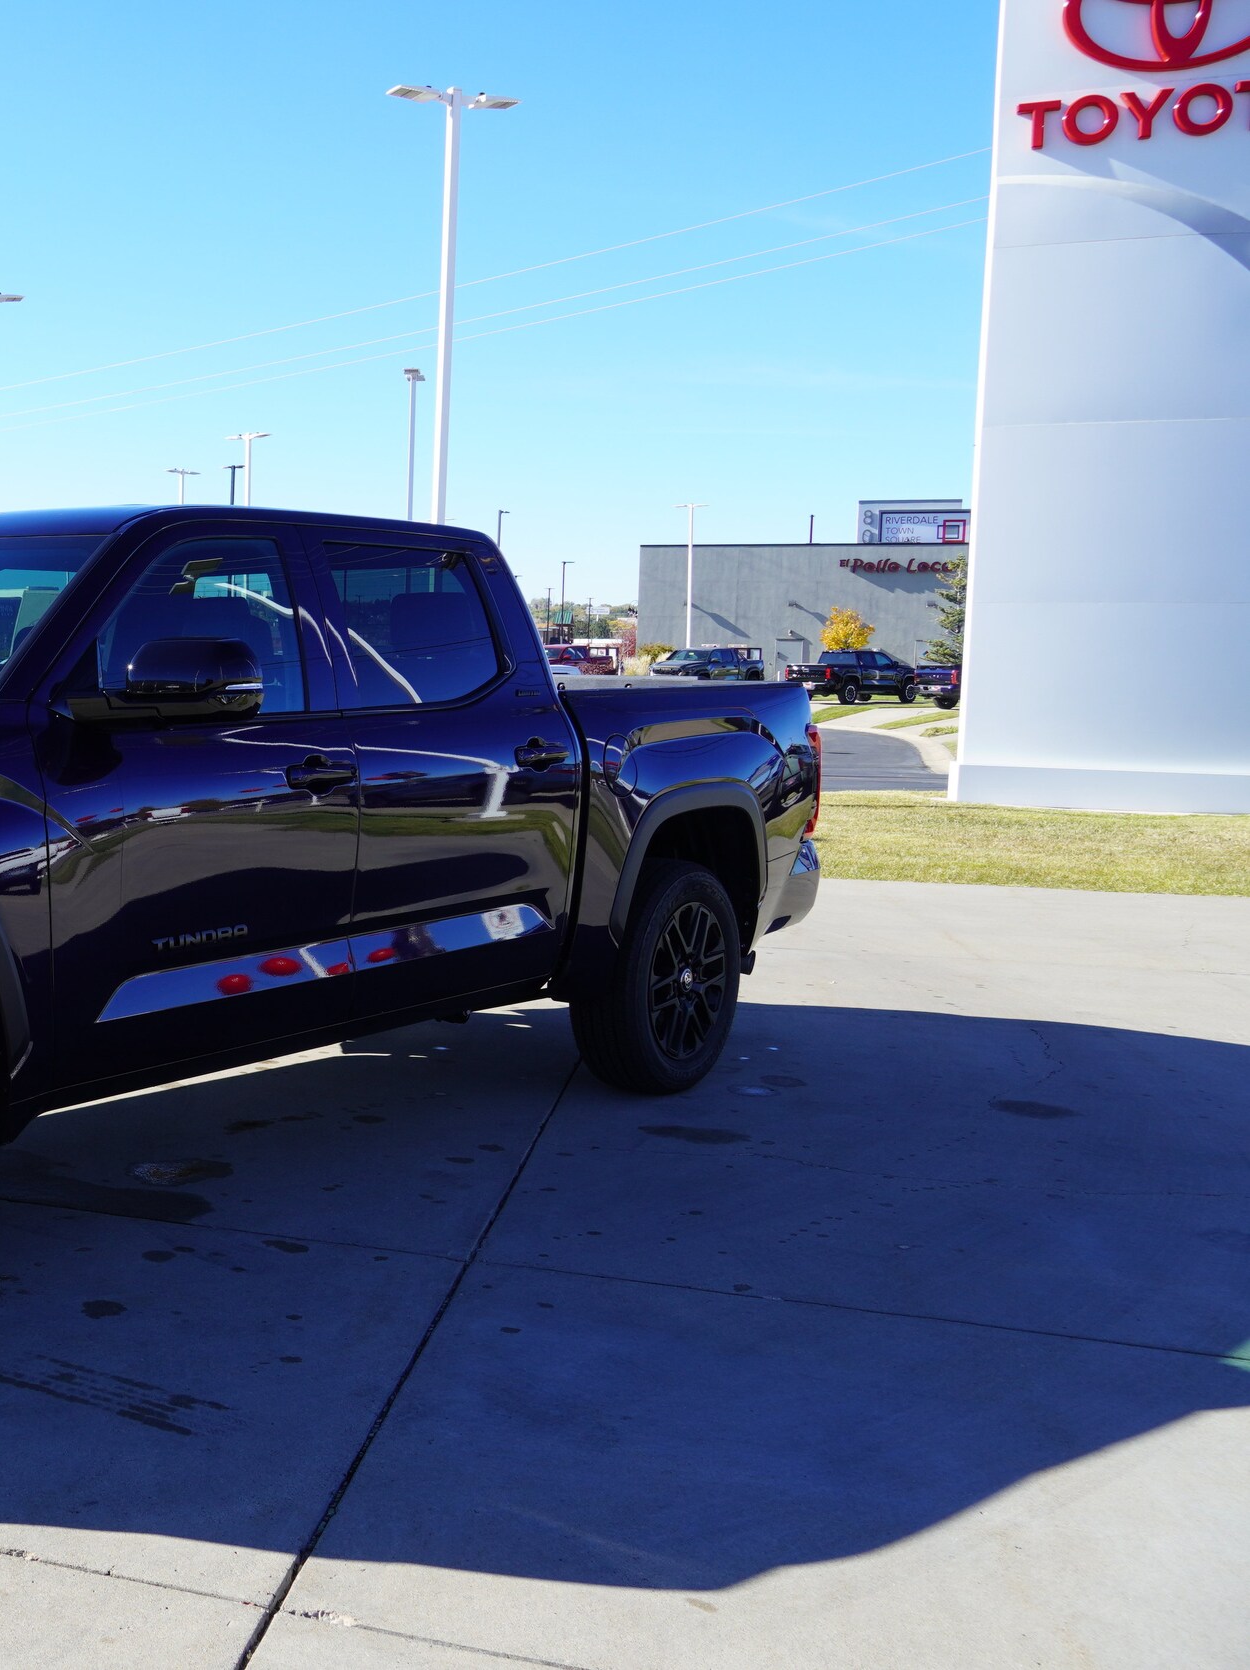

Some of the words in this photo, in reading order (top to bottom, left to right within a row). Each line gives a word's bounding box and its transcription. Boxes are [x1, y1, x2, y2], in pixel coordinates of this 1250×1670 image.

[885, 516, 939, 524] RIVERDALE
[839, 559, 850, 567] El
[853, 558, 901, 573] Pollo
[151, 923, 249, 951] TUNDRA
